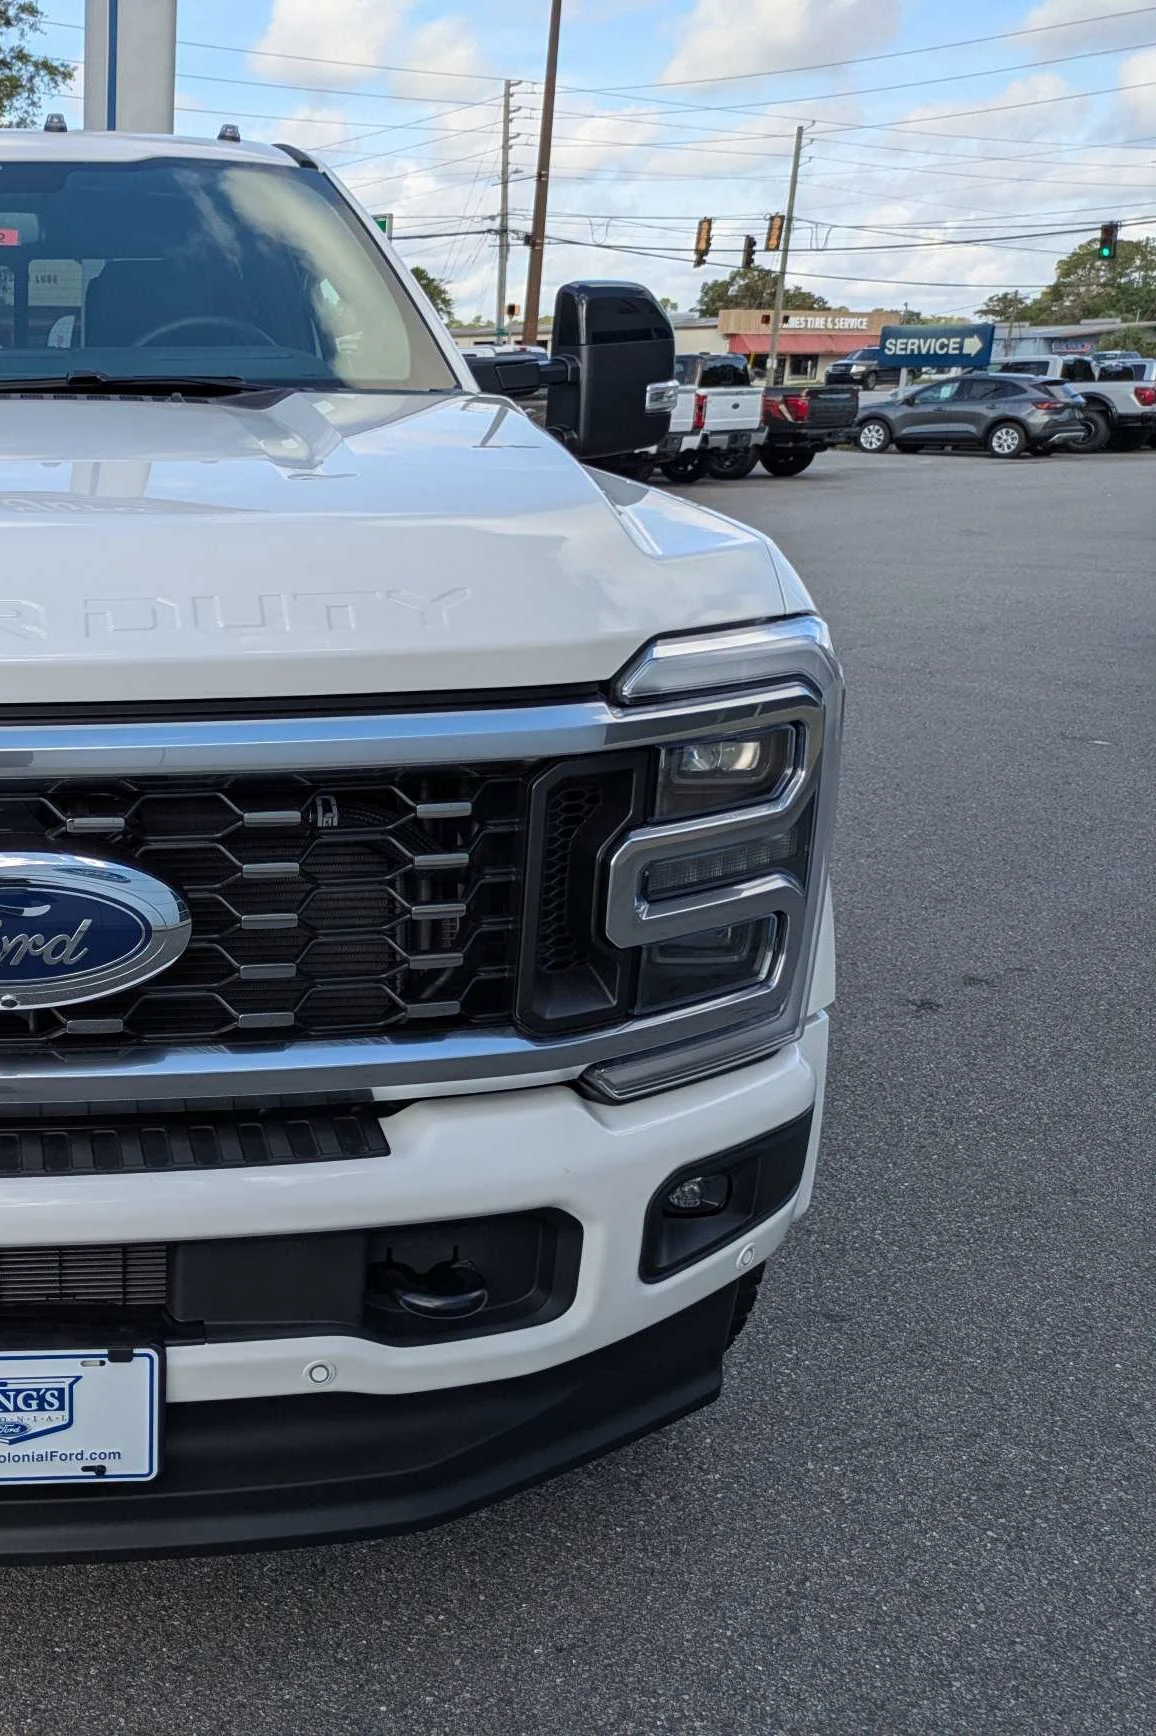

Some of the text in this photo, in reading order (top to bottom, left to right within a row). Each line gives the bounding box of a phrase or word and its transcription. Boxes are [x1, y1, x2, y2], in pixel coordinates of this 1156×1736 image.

[807, 317, 826, 329] TIRE
[827, 317, 833, 329] &
[834, 317, 868, 330] SERVICE
[884, 338, 962, 355] SERVICE
[83, 586, 473, 639] DUTY
